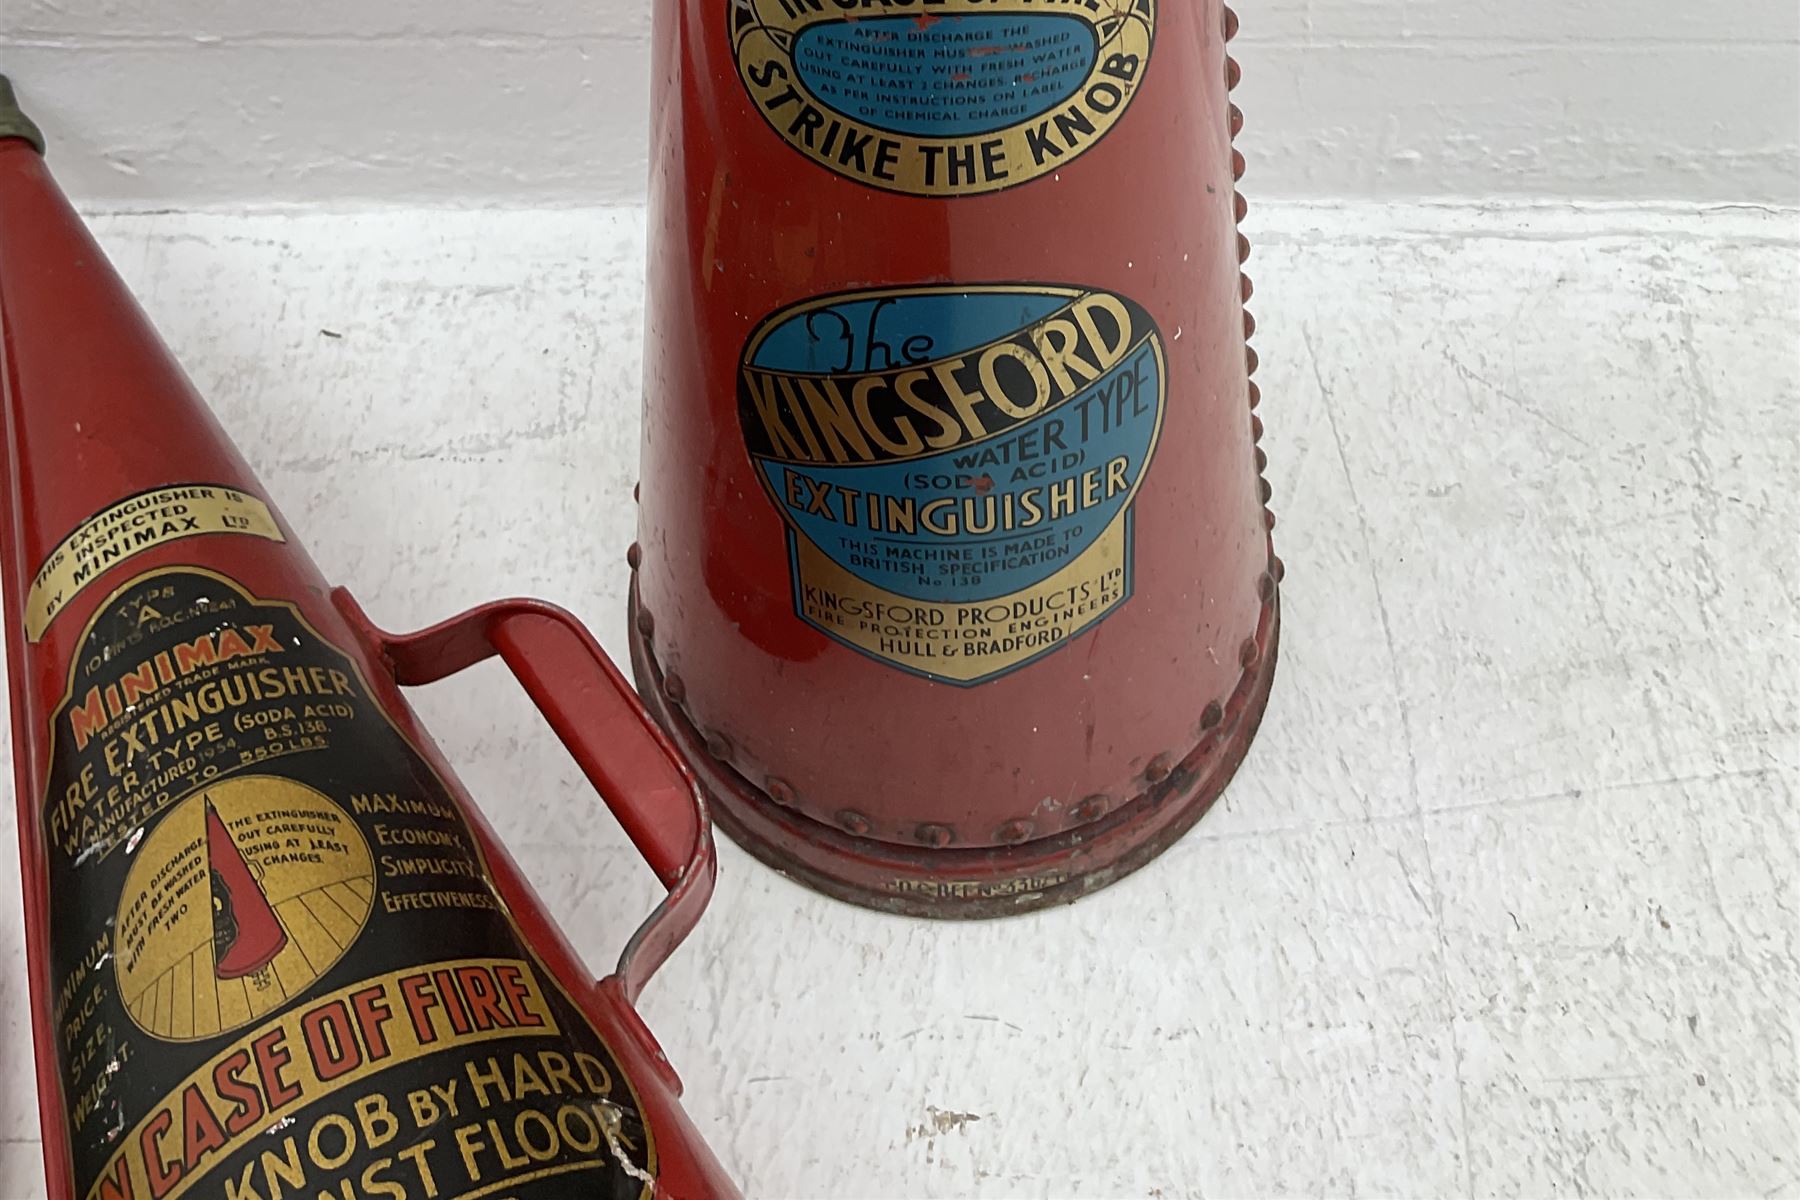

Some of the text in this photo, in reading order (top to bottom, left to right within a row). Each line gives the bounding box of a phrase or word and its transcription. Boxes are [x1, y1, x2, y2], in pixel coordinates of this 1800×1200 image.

[805, 44, 1081, 74] OUT CAREFULLY WITH FRESH WATER
[818, 36, 925, 58] EXTINGUISHER
[934, 49, 974, 58] MUS
[855, 24, 1030, 43] AFTER DISCHARGE THE
[800, 62, 841, 80] USING
[847, 74, 863, 84] AT
[871, 77, 913, 89] LEAST
[1015, 57, 1086, 83] RCHARGE
[821, 81, 1064, 106] AS PER INSTRUCTIONS ON LABEL
[748, 52, 1139, 186] STRIKE THE KNOB
[859, 104, 1027, 121] OF CHEMICAL CHARGE
[806, 300, 935, 374] The
[743, 293, 1133, 465] KINGSFORD
[953, 350, 1150, 470] WATER TYPE
[1010, 450, 1086, 484] ACID)
[783, 455, 1130, 537] EXTINGUISHER
[36, 488, 243, 590] THIS EXTINGUISHER IS
[75, 504, 188, 562] INSPECTED
[839, 525, 1083, 561] THIS MACHINE IS MADE TO
[851, 544, 1069, 576] BRITISH SPECIFICATION
[46, 590, 63, 616] BY
[73, 516, 200, 586] MINIMAX
[116, 586, 175, 618] TYPE
[137, 604, 162, 628] A
[805, 583, 944, 626] KINGSFORD
[958, 580, 1089, 626] PRODUCTS
[808, 589, 1119, 640] FIRE PROTECTION ENGINEERS
[880, 638, 936, 657] HULL
[966, 627, 1063, 657] BRADFORD
[70, 624, 285, 751] MINIMAX
[175, 667, 220, 689] TRADE
[51, 666, 356, 846] FIRE EXTINGUISHER
[64, 703, 354, 856] WATER TYPE (SODA ACID)
[187, 765, 218, 785] TO
[90, 756, 197, 847] MANUFACTURED
[351, 793, 456, 821] MAXIMUM
[121, 810, 341, 937] AFTER DISCHARGE THE EXTINGUISHER
[126, 823, 336, 950] MUST BE WASHED OUT CAREFULLY
[127, 838, 349, 974] WITH FRESH WATER USING AT LEAST
[164, 904, 188, 932] TWO
[139, 1025, 305, 1200] CASE
[301, 982, 408, 1083] OF
[399, 964, 544, 1048] FIRE
[224, 1051, 613, 1200] KNOB BY HARD
[455, 1102, 638, 1182] FLOOR
